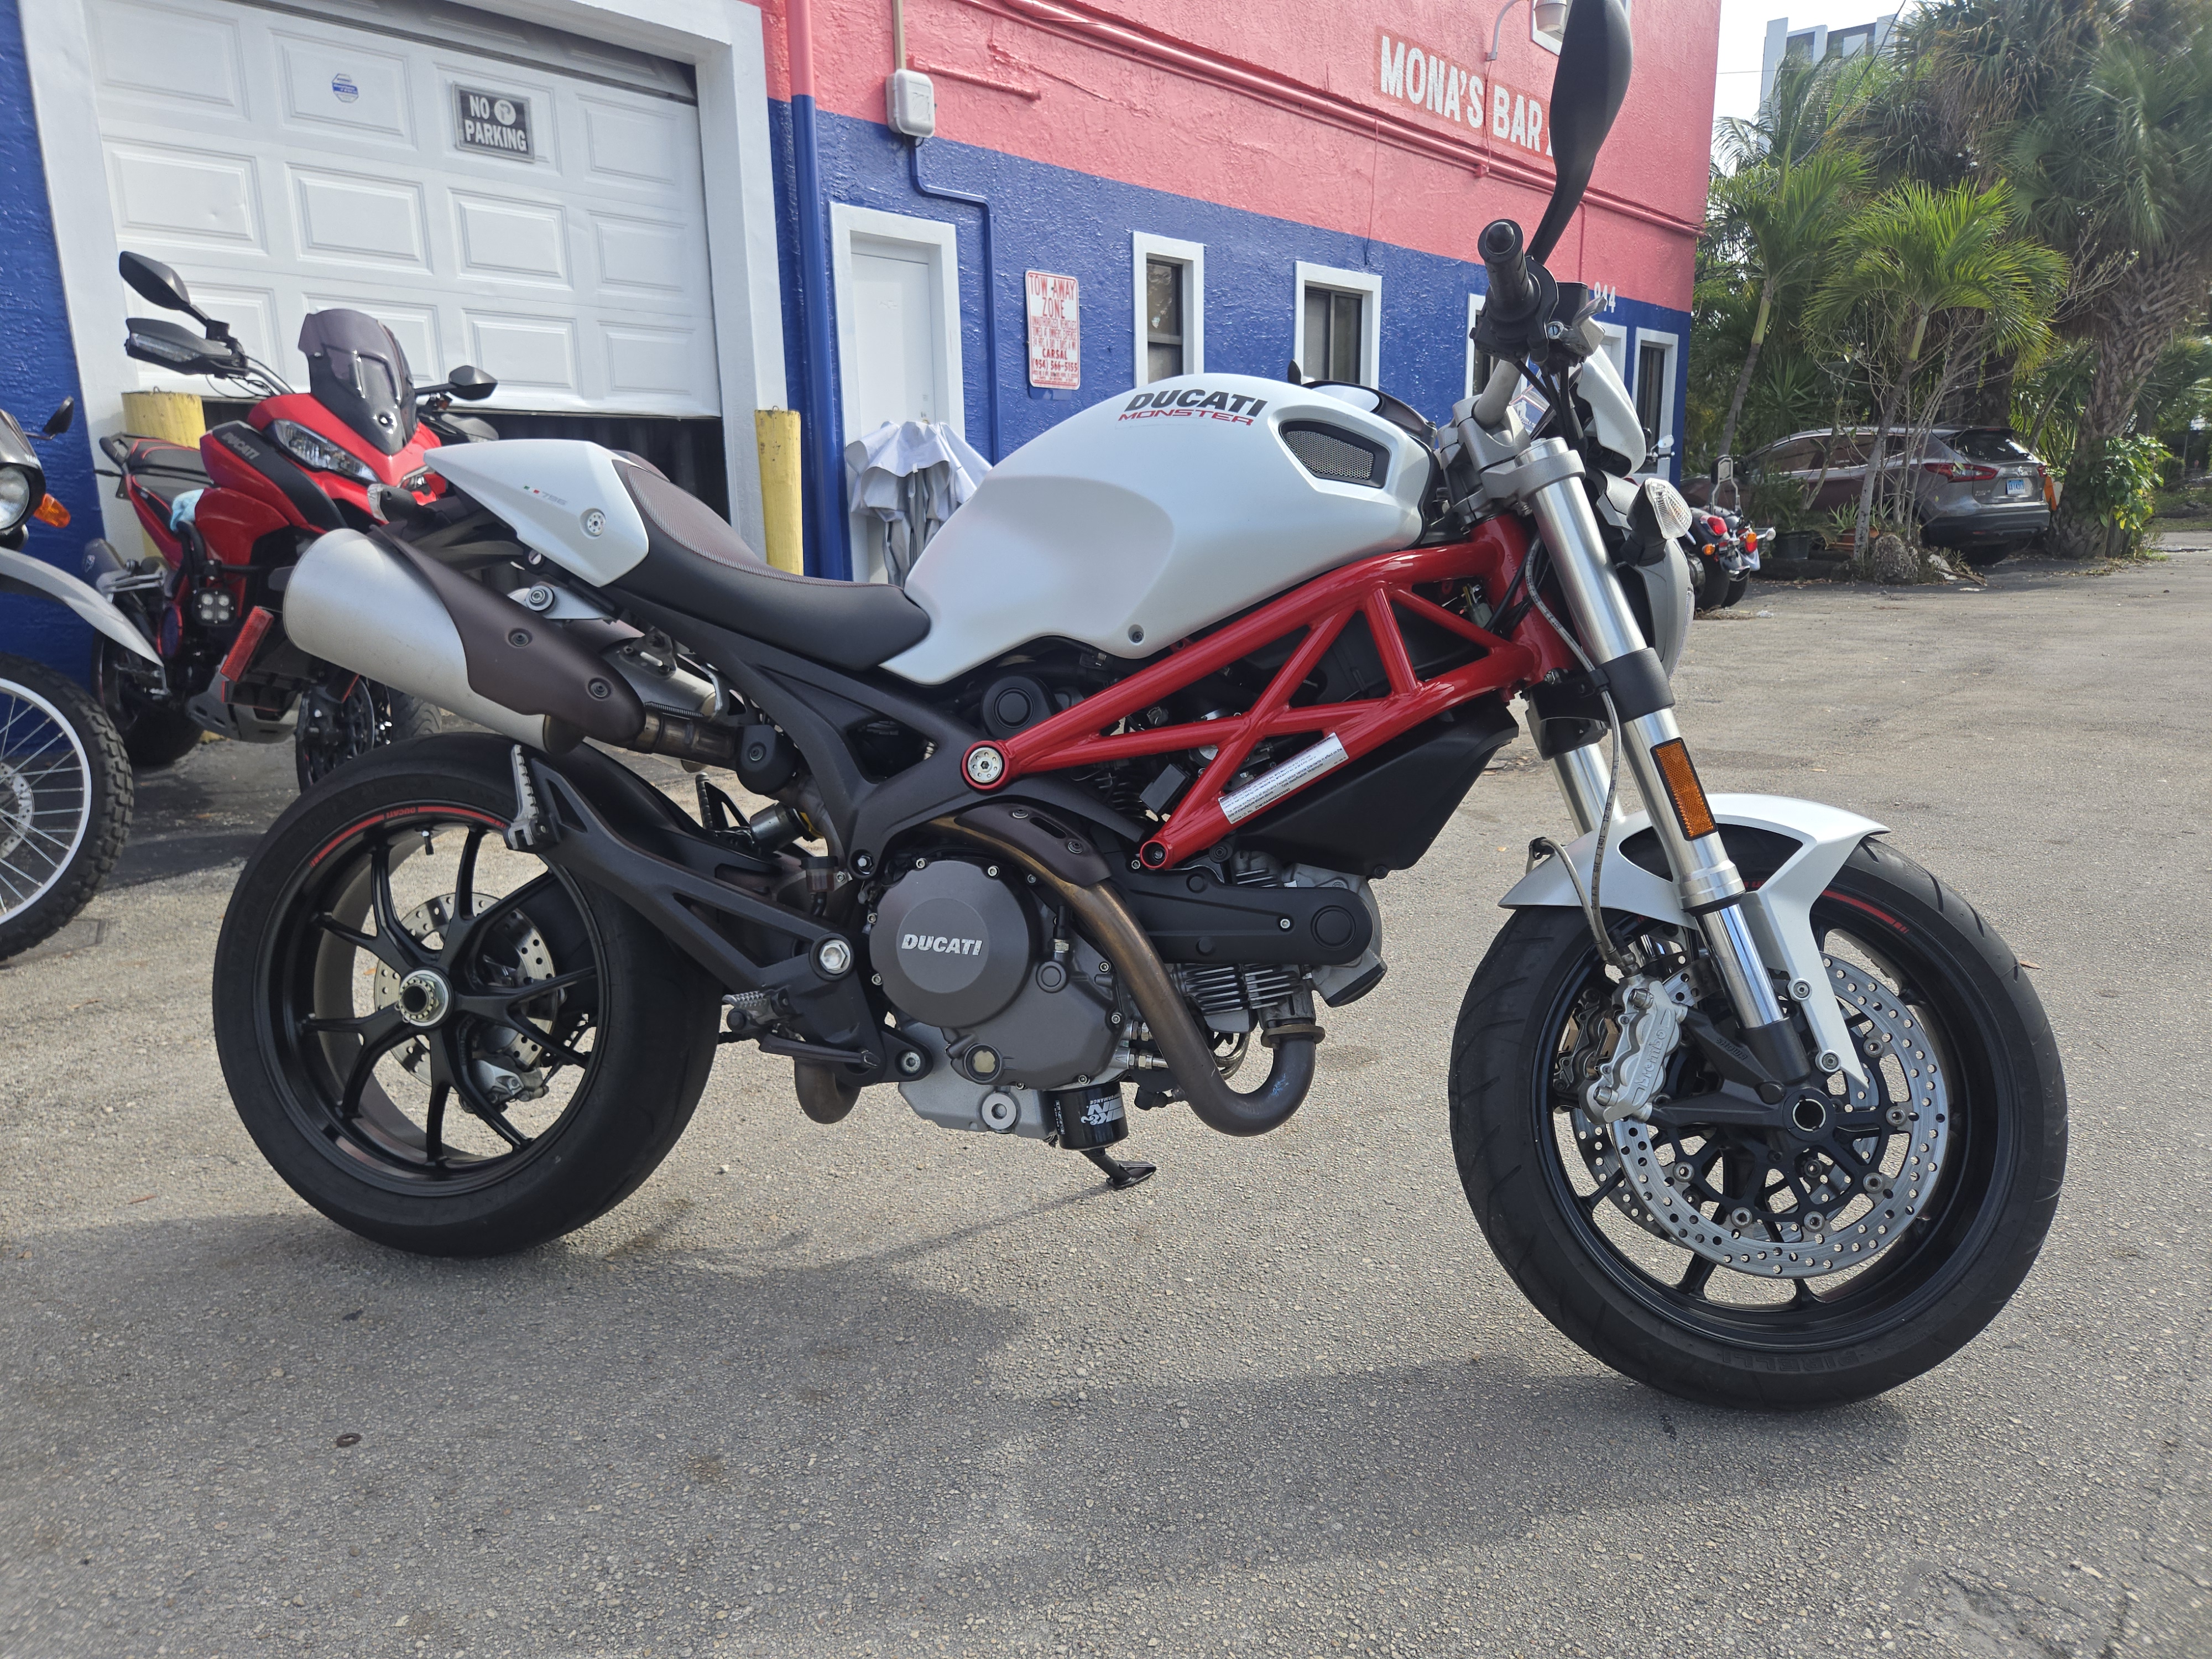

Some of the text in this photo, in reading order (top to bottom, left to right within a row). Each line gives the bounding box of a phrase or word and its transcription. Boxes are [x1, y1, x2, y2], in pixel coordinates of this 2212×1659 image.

[1381, 35, 1542, 152] MONA'S BAR
[469, 95, 490, 119] NO
[465, 119, 527, 152] PARKING
[1030, 275, 1076, 300] TOW AWAY
[1042, 297, 1065, 319] ZONE
[1033, 358, 1078, 372] (954) 566-5155
[1042, 348, 1067, 360] CARSAL
[1124, 389, 1268, 418] DUCATI
[1118, 409, 1254, 426] MONSTER
[222, 432, 260, 460] DUCATI
[901, 934, 982, 956] DUCATI
[1634, 1030, 1667, 1088] brembo
[1716, 1038, 1748, 1060] SHOWA
[1723, 1350, 1860, 1371] PIRELLI
